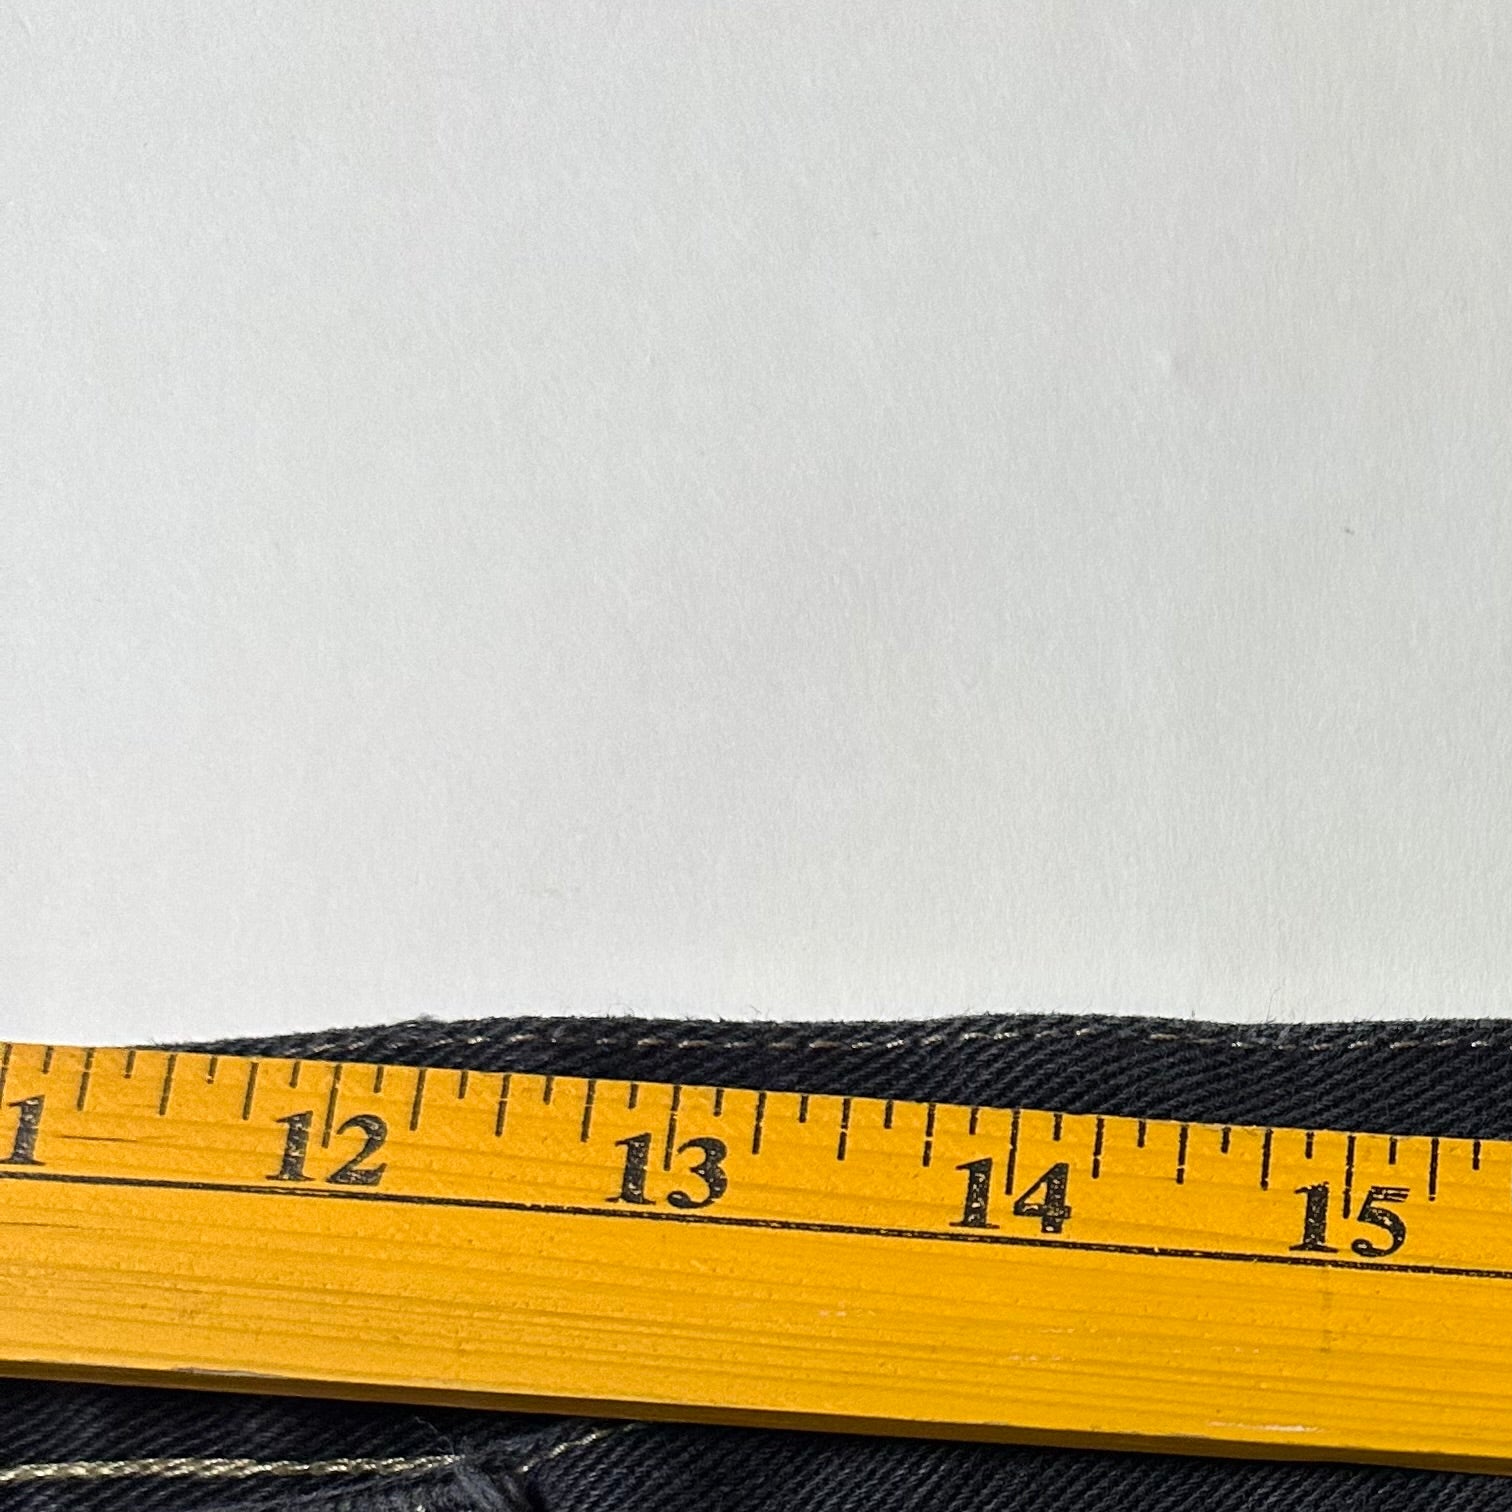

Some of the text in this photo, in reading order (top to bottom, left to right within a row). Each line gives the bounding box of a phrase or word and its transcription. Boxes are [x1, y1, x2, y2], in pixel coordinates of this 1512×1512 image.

[266, 1109, 389, 1186] 12
[606, 1131, 729, 1209] 13
[946, 1156, 1073, 1235] 14
[1288, 1183, 1411, 1257] 15
